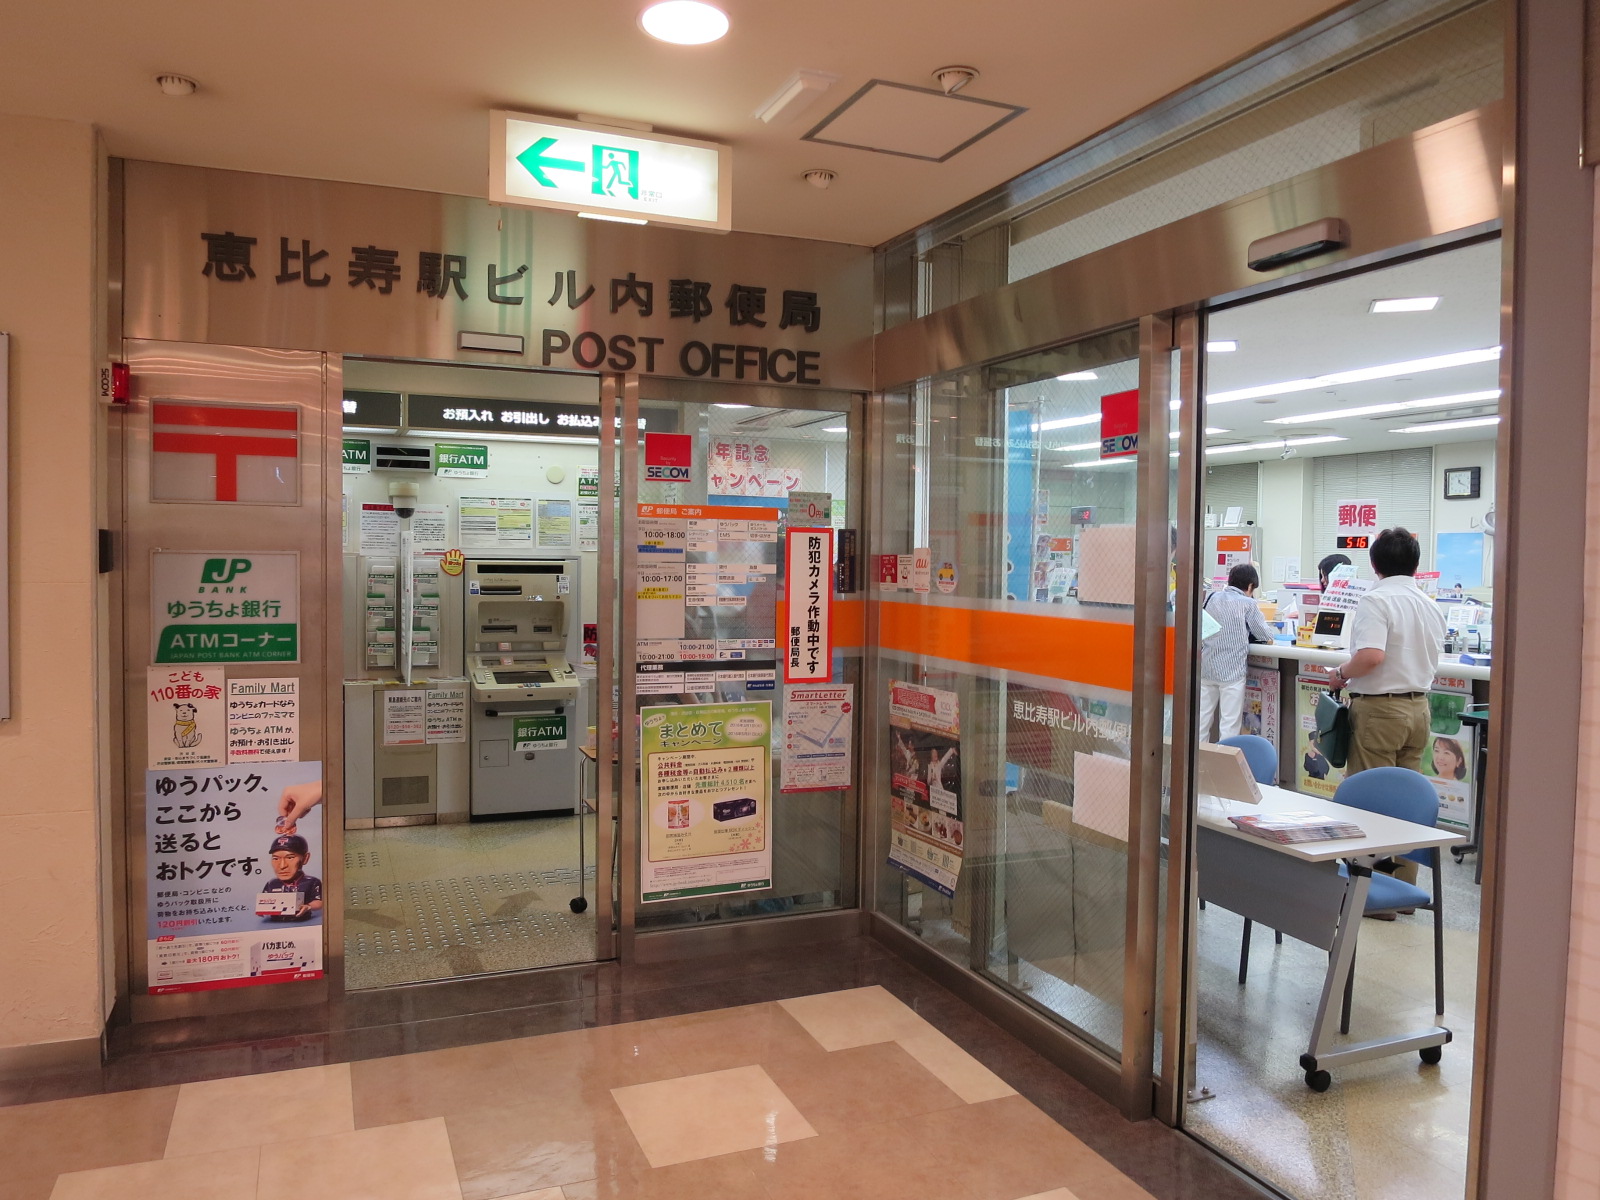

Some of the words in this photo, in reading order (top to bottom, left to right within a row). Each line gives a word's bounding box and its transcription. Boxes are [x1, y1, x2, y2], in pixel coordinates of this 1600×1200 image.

[200, 230, 821, 334] 恵比寿駅ビル内郵便局
[542, 328, 664, 376] POST
[679, 339, 821, 386] OFFICE
[101, 368, 109, 397] SECOM
[442, 408, 494, 422] お預入れ
[500, 411, 550, 425] お引出し
[342, 449, 366, 460] ATM
[439, 453, 484, 465] 銀行ATM
[647, 466, 689, 479] SECOM
[681, 508, 701, 516] ご案内
[1338, 504, 1377, 527] 郵便
[1066, 540, 1071, 549] 5
[1241, 538, 1248, 549] 3
[1346, 537, 1366, 549] 516
[916, 559, 927, 568] au
[200, 558, 252, 583] JP
[198, 586, 248, 594] BANK
[167, 600, 282, 618] ゆうちょ銀行
[807, 537, 821, 674] 防犯カメラ作動中です
[170, 631, 292, 649] ATMコーナー
[790, 627, 800, 668] 郵便局長
[170, 651, 195, 659] JAPAN
[197, 651, 217, 659] POST
[220, 651, 240, 659] BANK
[262, 650, 292, 658] CORNER
[168, 670, 204, 683] こども
[150, 684, 222, 702] 110番の家
[231, 683, 266, 694] Family
[271, 682, 295, 693] Mart
[450, 691, 464, 699] Mart
[791, 690, 846, 700] SmartLetter
[230, 700, 295, 709] ゆうちょカードなら
[230, 711, 295, 720] コンビニのファミマで
[230, 727, 262, 735] ゆうちょ
[264, 726, 283, 734] ATM
[517, 726, 563, 738] 銀行ATM
[660, 721, 723, 739] まとめて
[230, 738, 295, 747] お預け・お引き出し
[660, 738, 722, 747] キャンペーン
[658, 761, 683, 769] 公共料金
[156, 774, 269, 796] ゆうパック、
[155, 801, 242, 825] ここから
[155, 831, 221, 854] 送ると
[155, 858, 262, 881] おトクです。
[157, 887, 232, 898] 郵便局・コンビニなどの
[157, 897, 219, 907] ゆうパック取扱所に
[157, 905, 249, 917] 荷物をお持ち込みいただくと、
[157, 916, 232, 928] 120円割引いたします。
[267, 951, 294, 959] ゆうパック
